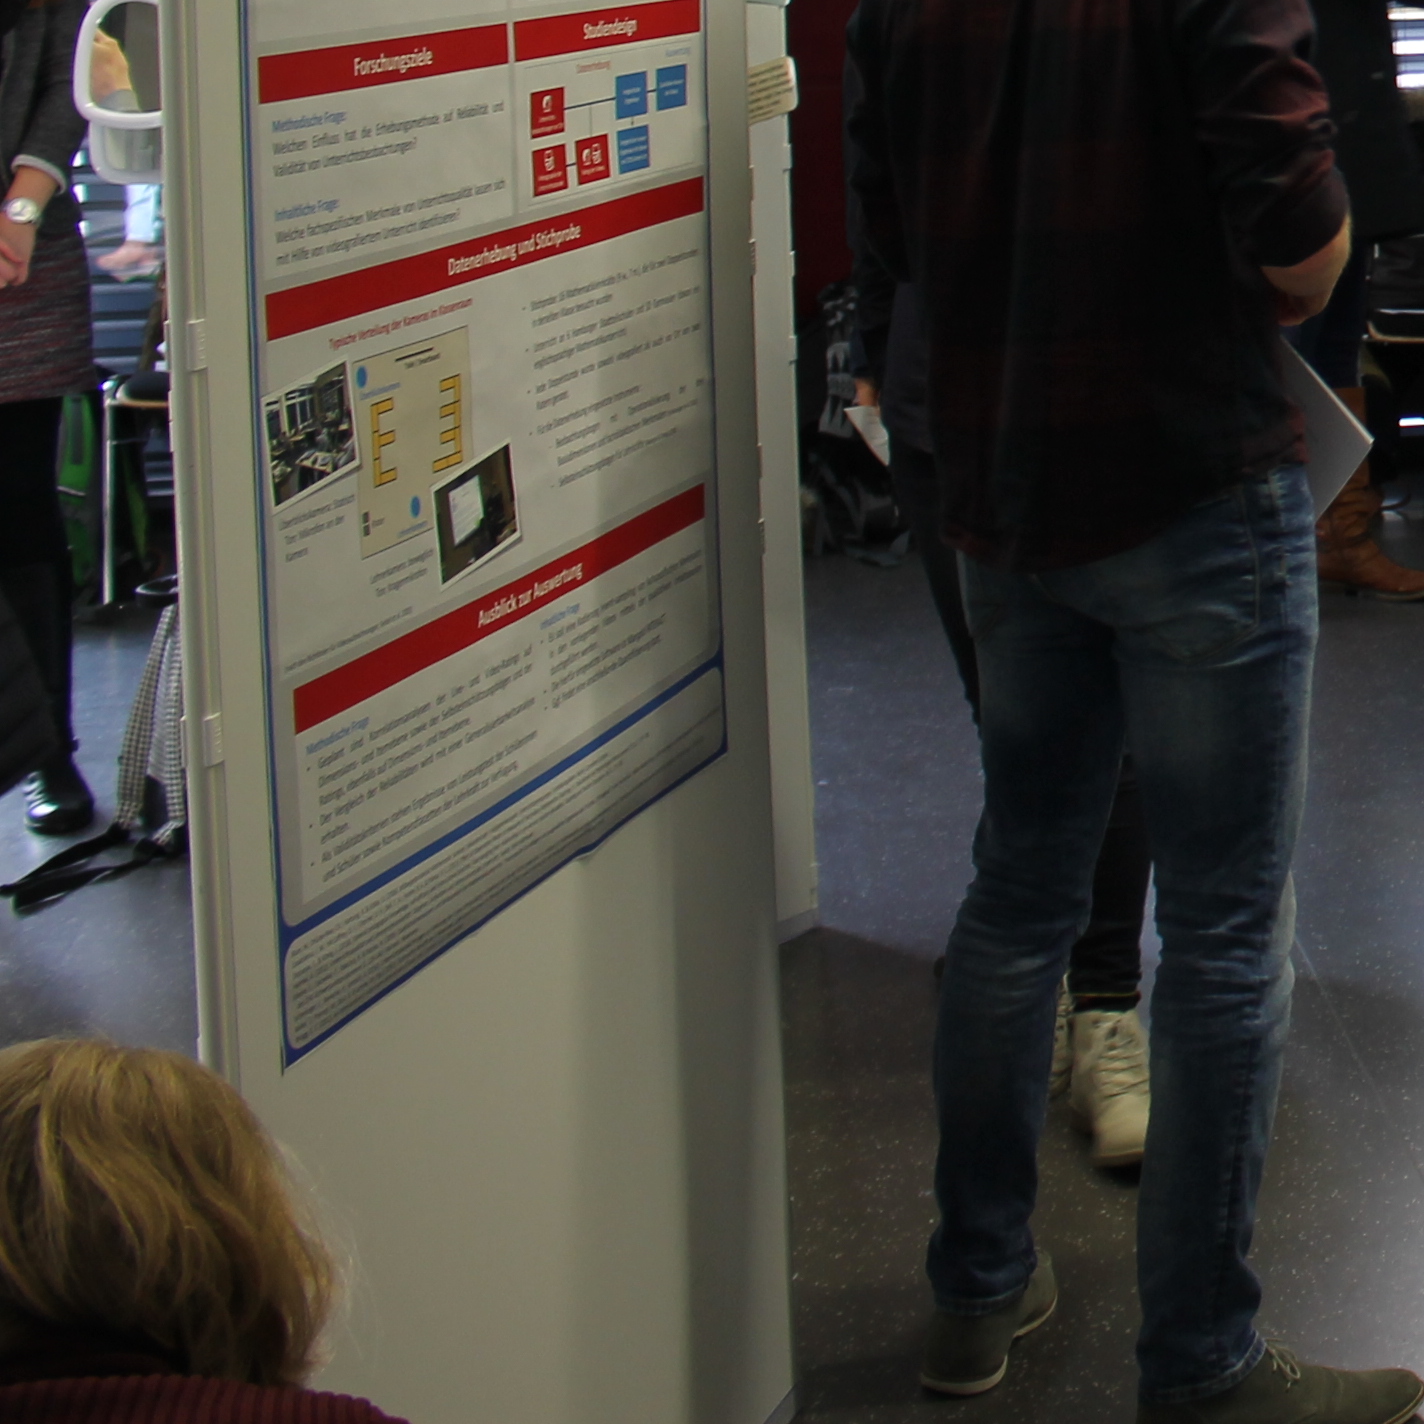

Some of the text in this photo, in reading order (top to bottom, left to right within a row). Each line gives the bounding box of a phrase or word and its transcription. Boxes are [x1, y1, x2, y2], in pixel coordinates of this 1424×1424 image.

[583, 17, 638, 40] Studiendesign
[353, 47, 433, 76] Forschungsziele
[447, 224, 580, 274] Datenerhebung und Stichprobe
[478, 564, 582, 626] Ausblick zur Auswertung
